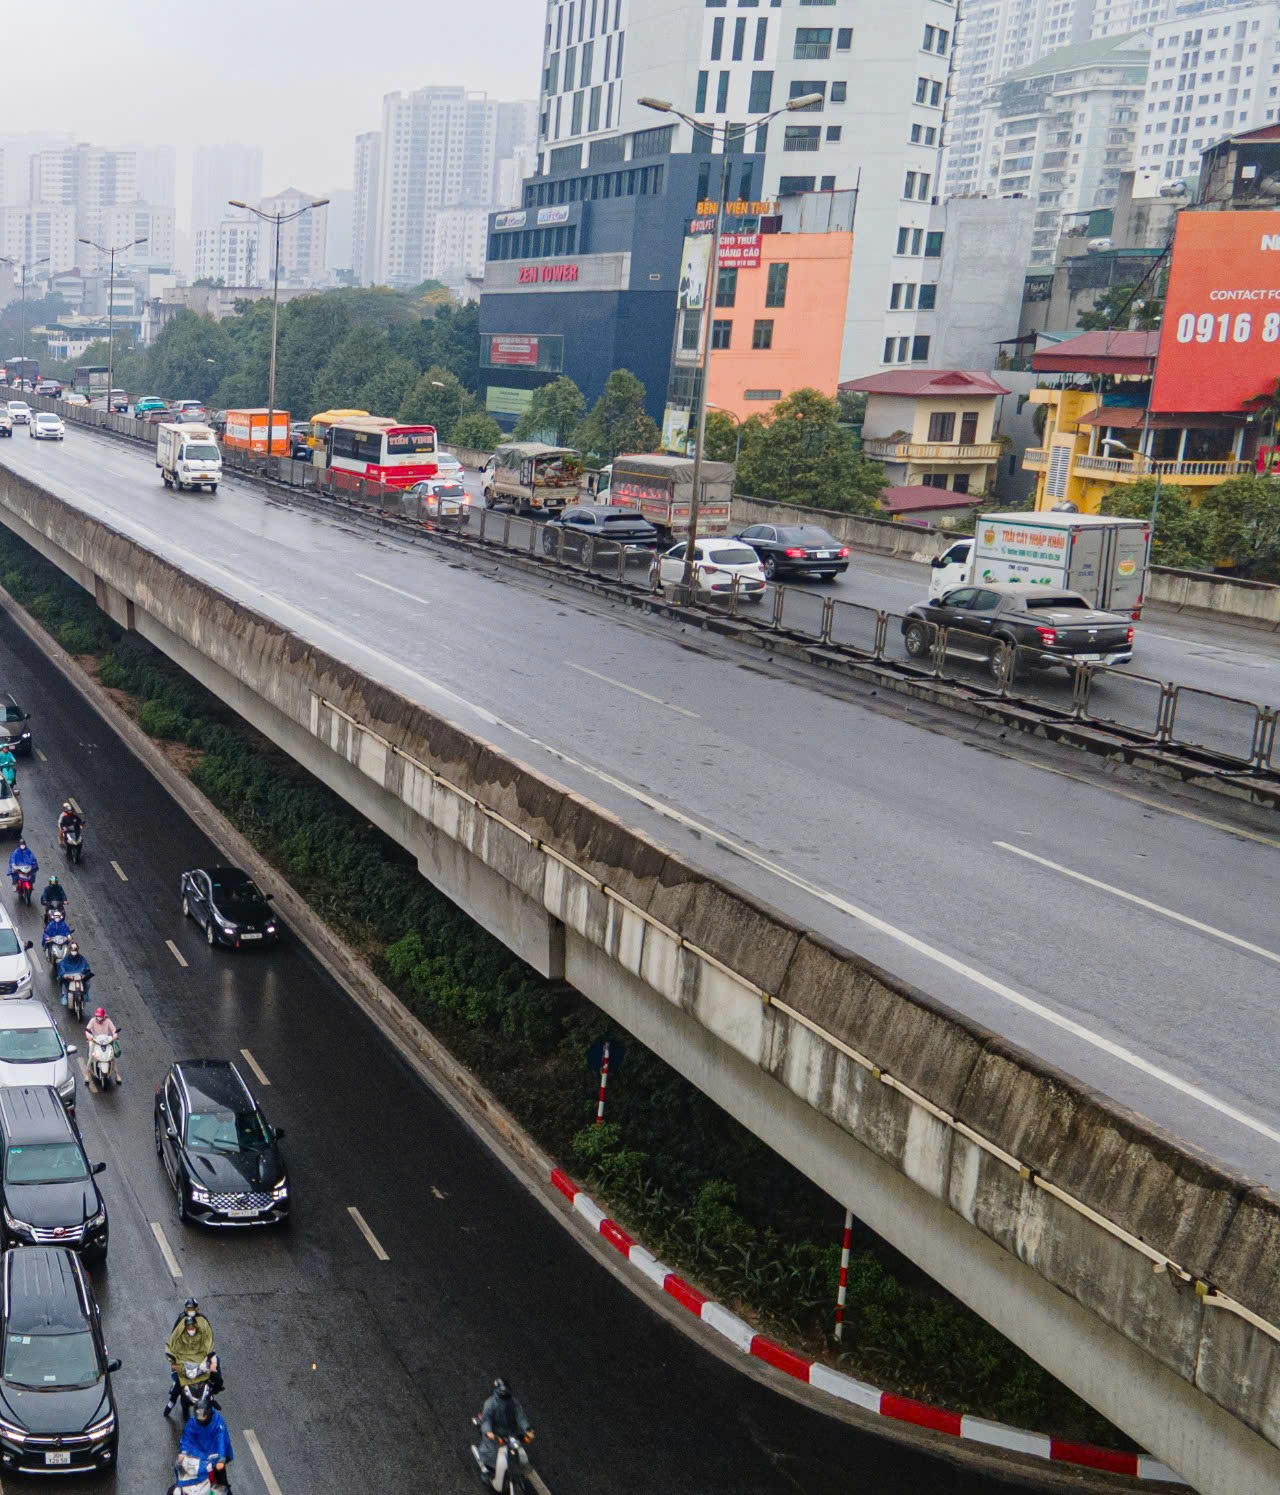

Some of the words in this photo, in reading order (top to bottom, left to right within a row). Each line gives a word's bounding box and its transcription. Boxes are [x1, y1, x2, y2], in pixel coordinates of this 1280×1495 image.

[696, 197, 719, 218] BỆN
[725, 197, 748, 218] VIỆN
[719, 246, 741, 257] UẢNG
[518, 266, 539, 284] ZEN
[540, 264, 578, 283] TOWER
[1209, 289, 1267, 300] CONTACT
[1176, 312, 1253, 343] 0916
